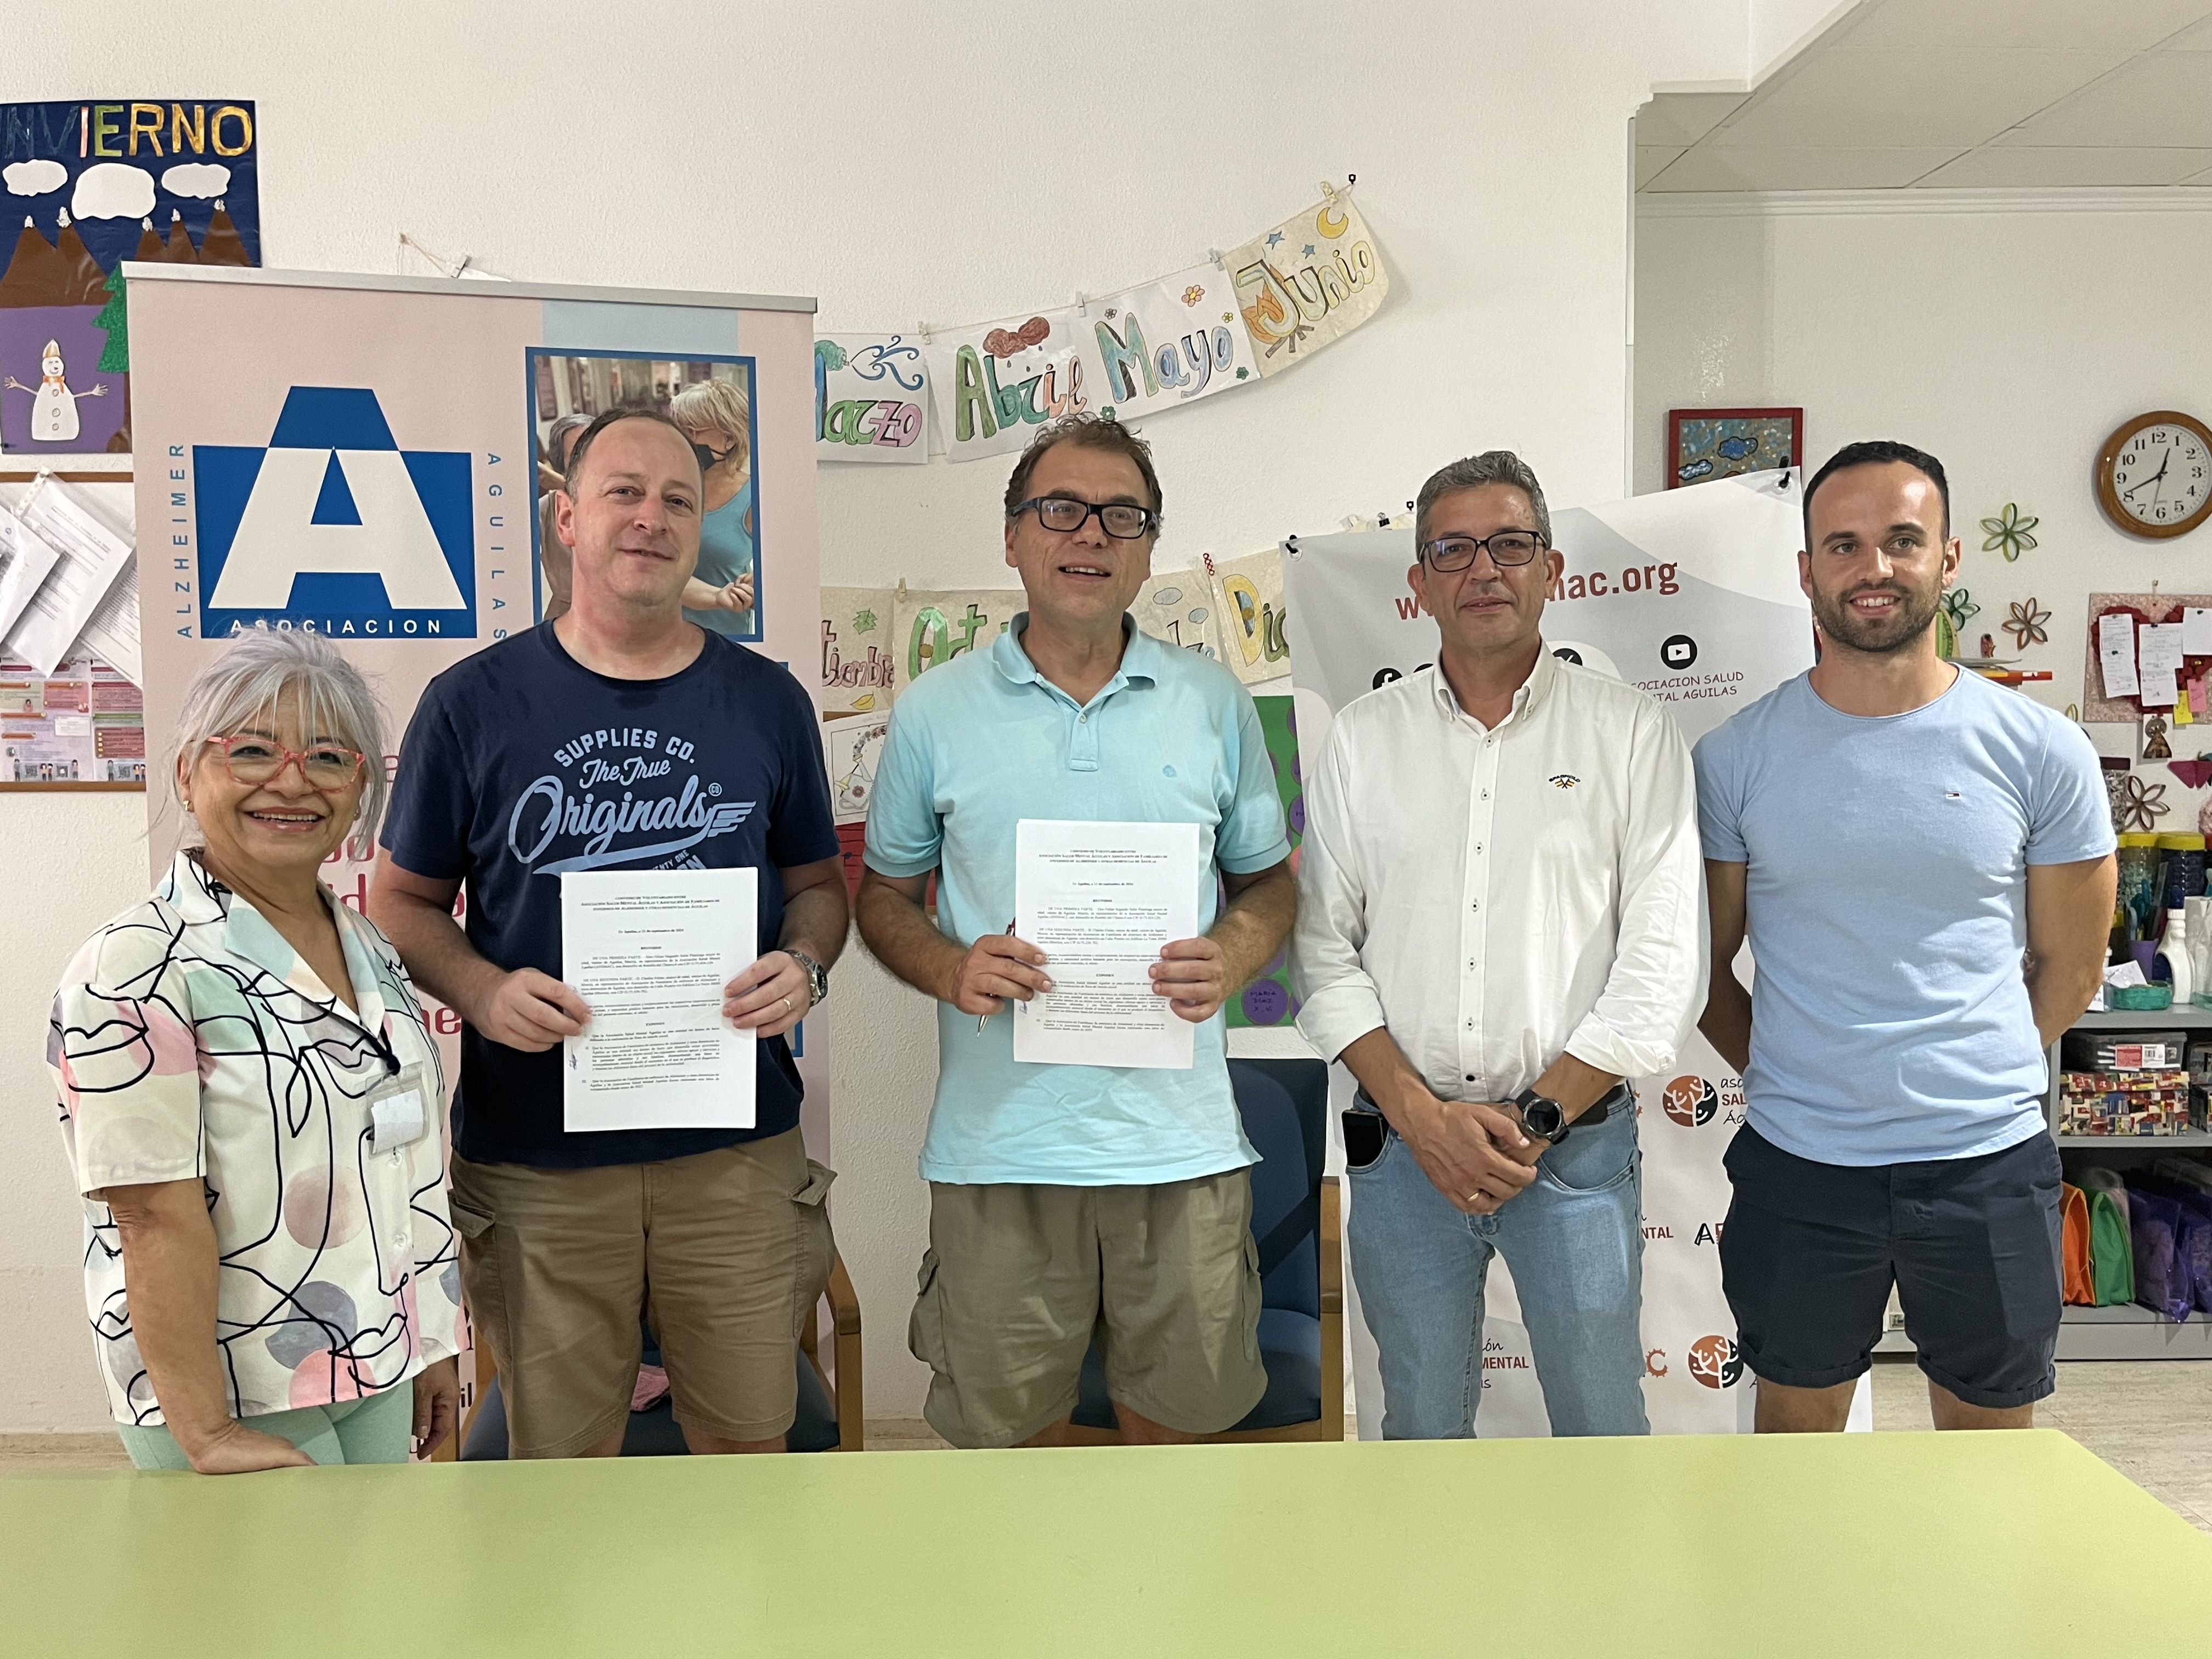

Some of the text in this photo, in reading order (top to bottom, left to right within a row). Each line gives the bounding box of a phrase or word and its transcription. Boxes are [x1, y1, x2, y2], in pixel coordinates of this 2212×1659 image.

[0, 103, 253, 159] NVIERNO
[1236, 241, 1375, 338] Junio
[1094, 313, 1233, 404] Mayo
[815, 351, 923, 448] arzo
[2135, 439, 2146, 450] 11
[2151, 431, 2166, 444] 12
[2174, 436, 2180, 447] 1
[2122, 454, 2135, 466] 10
[2186, 448, 2196, 460] 2
[2117, 472, 2127, 484] 9
[2192, 466, 2202, 478] 3
[2186, 485, 2196, 496] 4
[2137, 504, 2146, 515] 7
[2155, 506, 2165, 519] 6
[2174, 500, 2184, 513] 5
[169, 444, 193, 639] ALZHEIMER
[488, 453, 507, 639] AGUILAS
[230, 619, 441, 634] ASOCIACION
[1703, 671, 1744, 685] SALUD
[1683, 685, 1737, 699] AGUILAS
[554, 728, 695, 767] SUPPLIES CO.
[579, 756, 671, 789] The True
[508, 775, 713, 864] Originals
[674, 849, 690, 863] ONE
